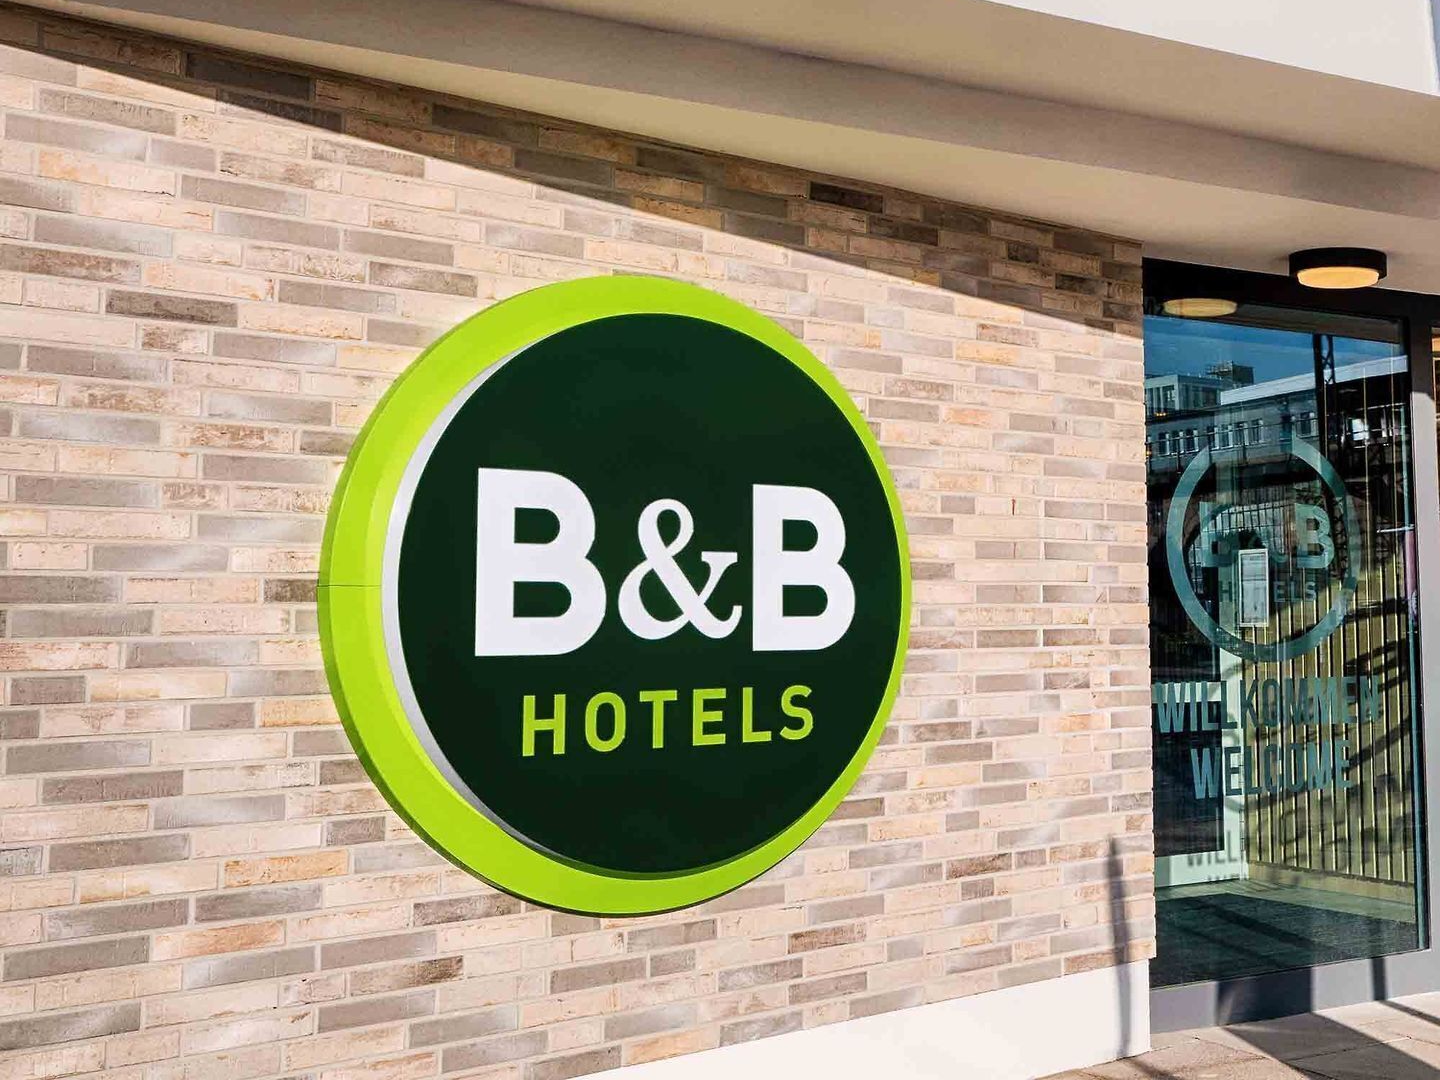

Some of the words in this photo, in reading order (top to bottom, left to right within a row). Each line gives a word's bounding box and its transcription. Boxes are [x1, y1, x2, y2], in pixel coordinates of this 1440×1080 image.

[475, 467, 856, 657] B&B
[522, 685, 814, 757] HOTELS
[1155, 676, 1382, 734] WILLKOMMEN
[1190, 740, 1351, 800] WELCOME
